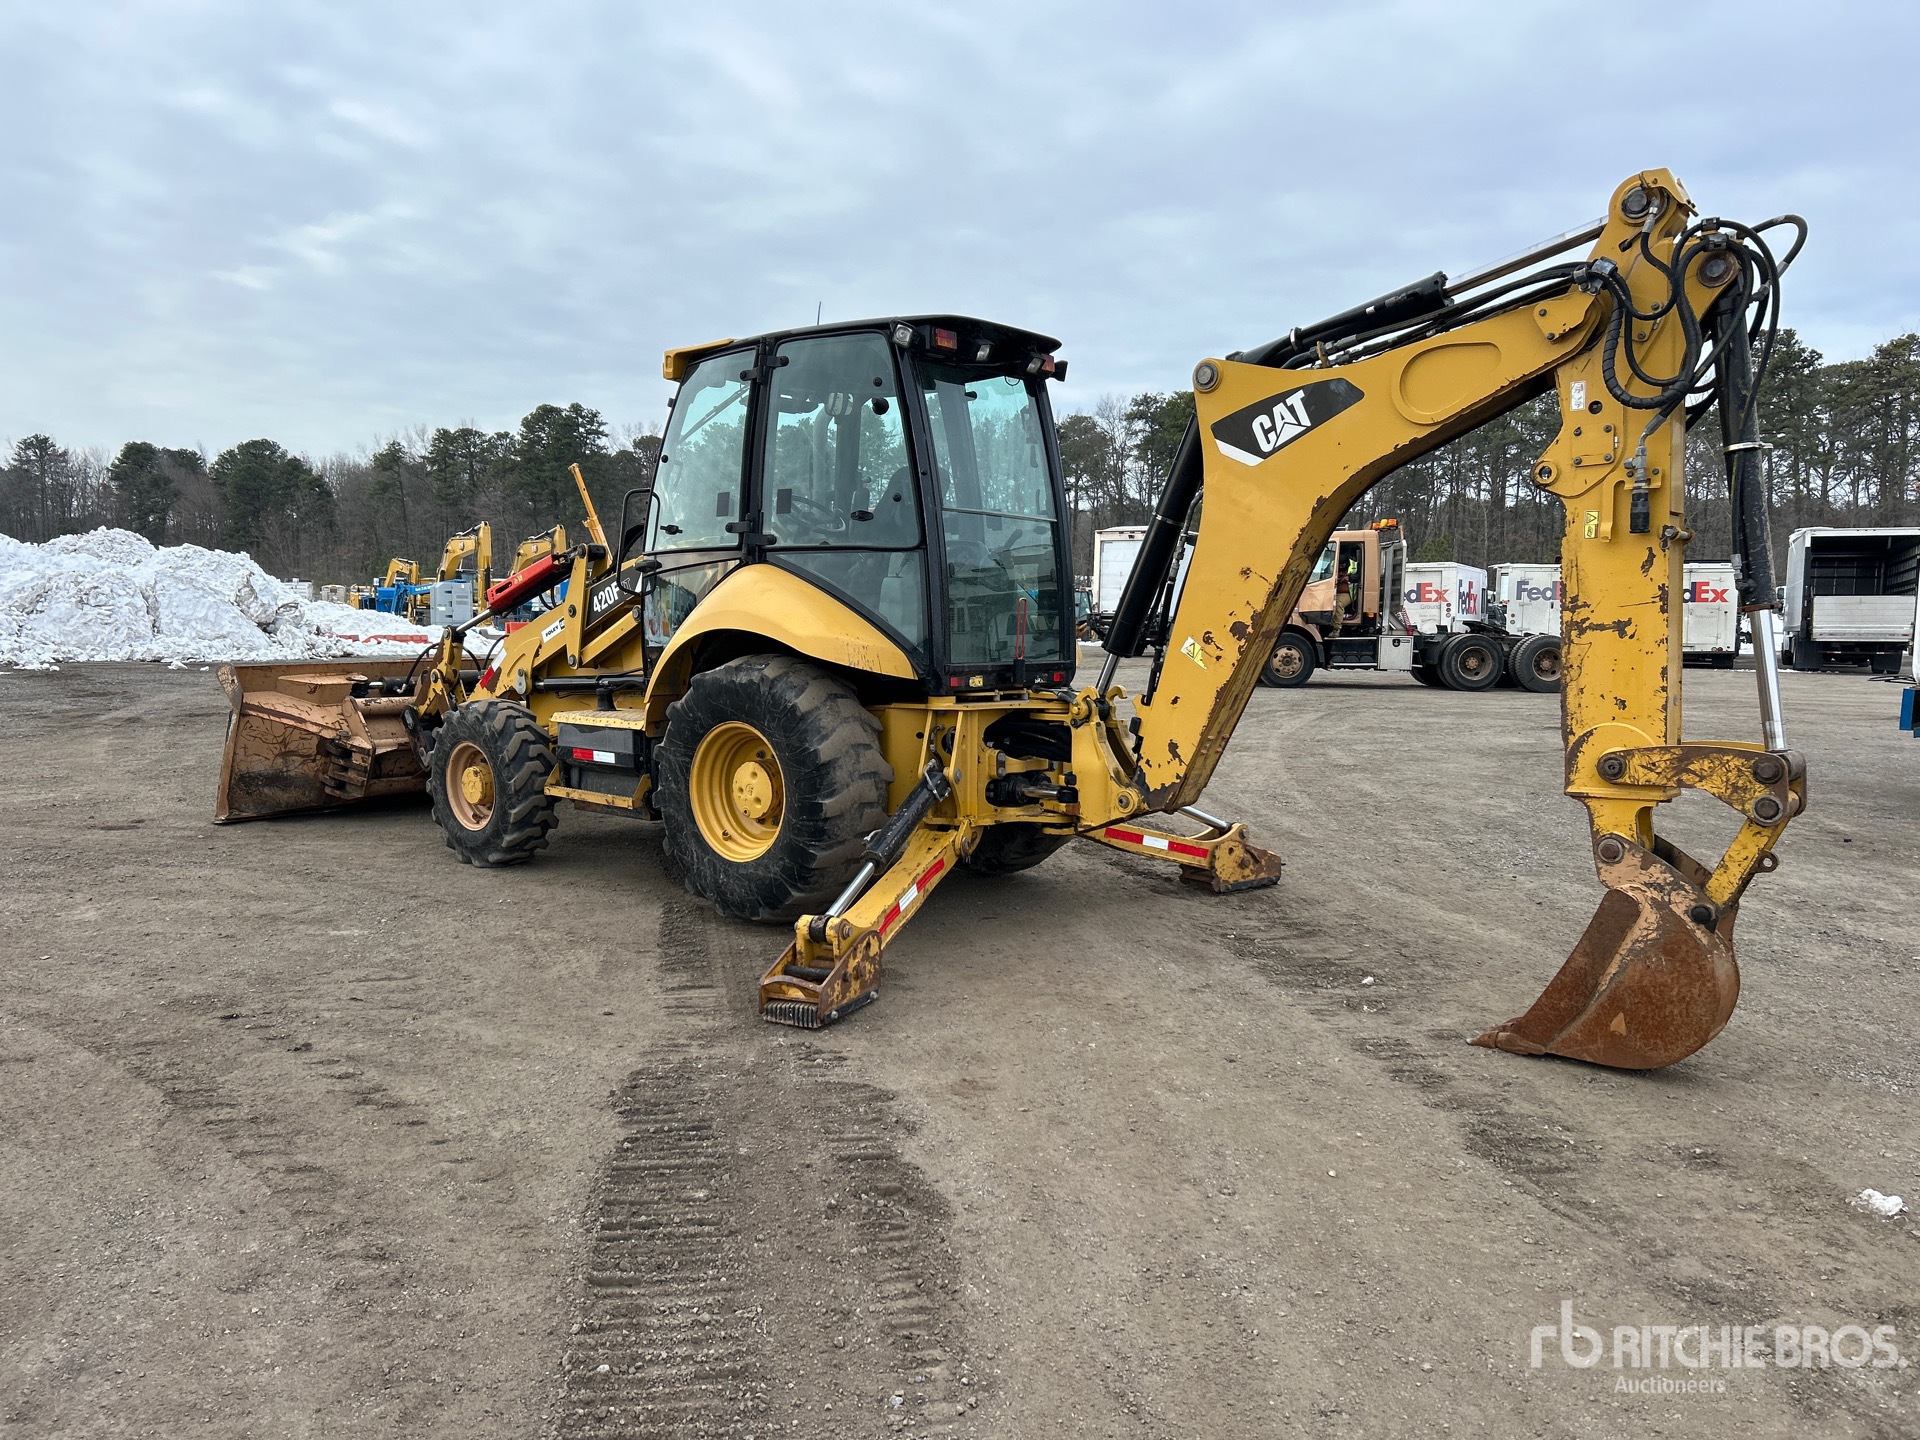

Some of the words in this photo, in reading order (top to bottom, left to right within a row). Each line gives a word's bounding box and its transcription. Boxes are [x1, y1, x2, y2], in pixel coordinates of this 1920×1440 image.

[1251, 389, 1312, 453] CAT
[593, 581, 620, 612] 420F
[1404, 582, 1450, 603] dEx
[1458, 579, 1478, 615] FedEx
[1516, 581, 1561, 601] Fed
[1683, 581, 1730, 603] dEx
